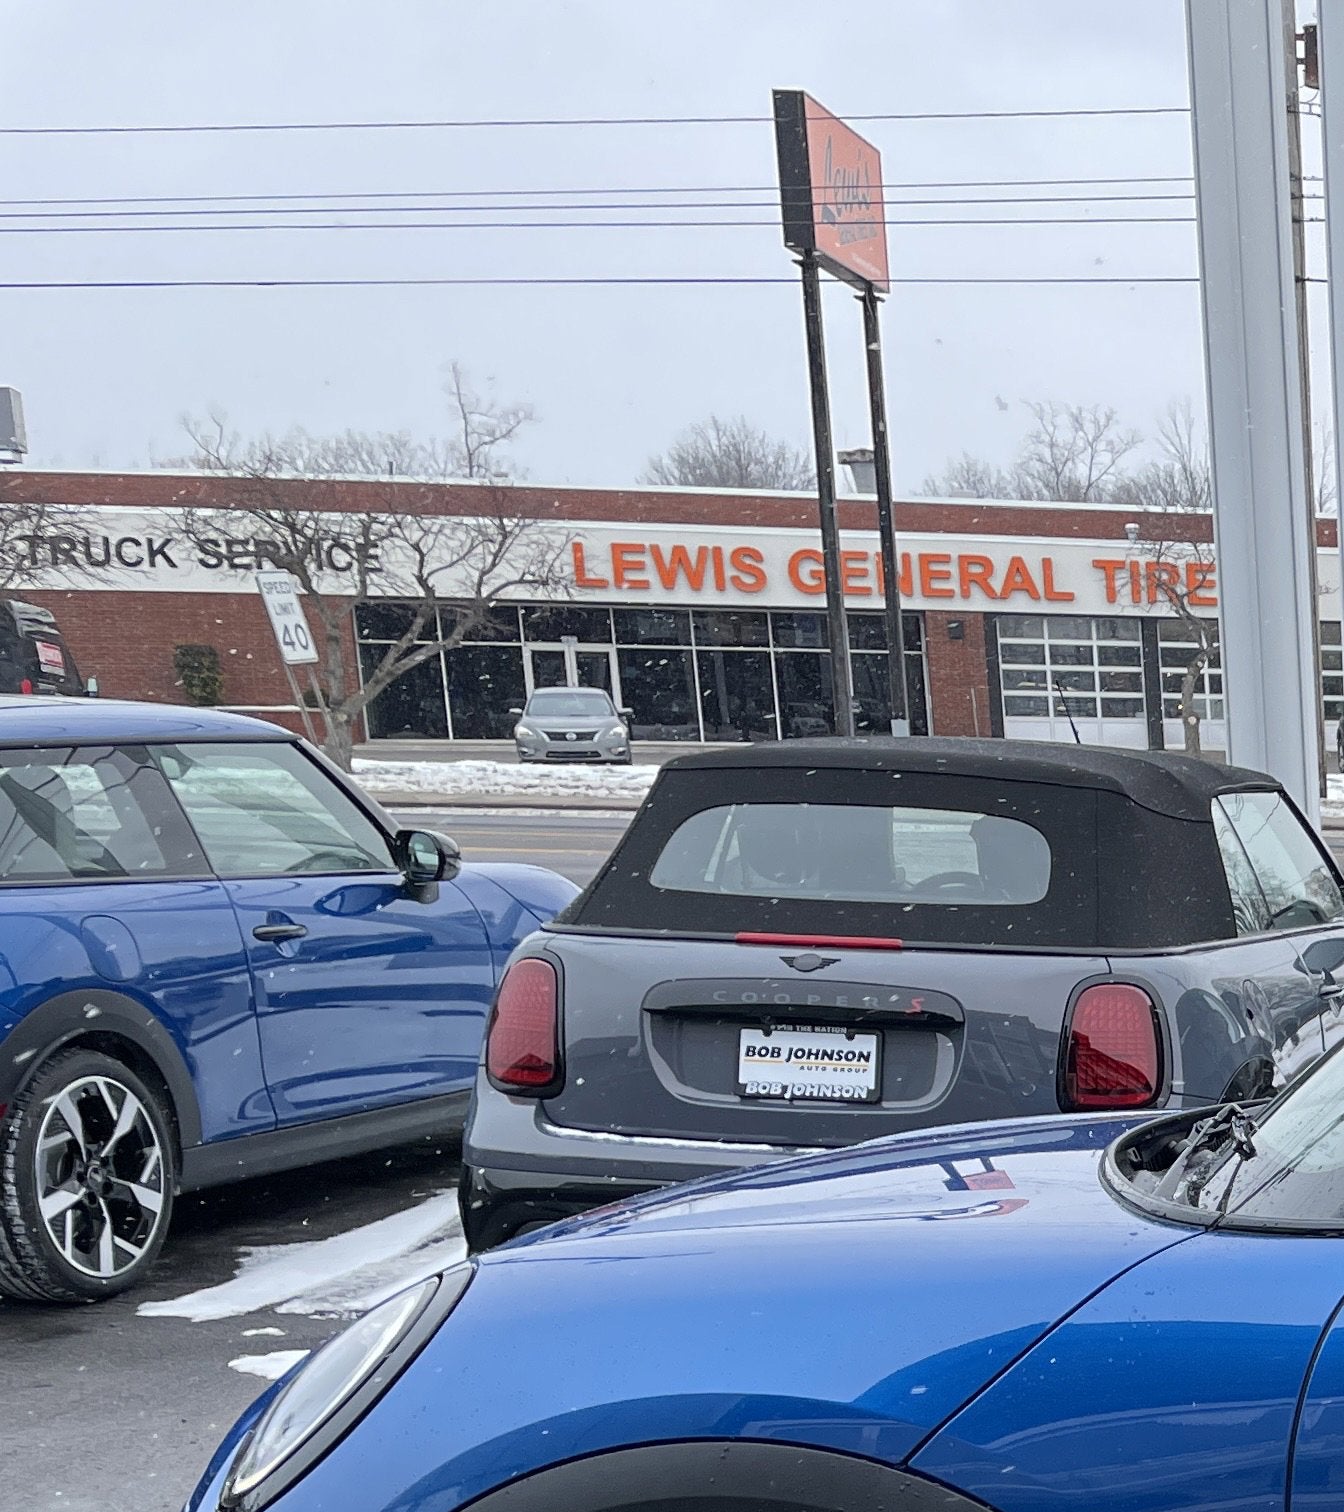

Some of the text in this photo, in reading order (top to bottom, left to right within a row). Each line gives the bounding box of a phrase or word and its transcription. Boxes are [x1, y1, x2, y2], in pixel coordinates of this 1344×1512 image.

[19, 535, 178, 569] TRUCK
[572, 542, 1218, 606] LEWIS GENERAL TIRE
[263, 581, 292, 594] SPEED
[274, 602, 297, 616] LIMIT
[282, 623, 309, 652] 40
[712, 990, 925, 1014] COOPER S
[745, 1045, 871, 1063] BOB JOHNSON
[832, 1066, 868, 1074] GROUP
[745, 1080, 868, 1099] BOB JOHNSON
